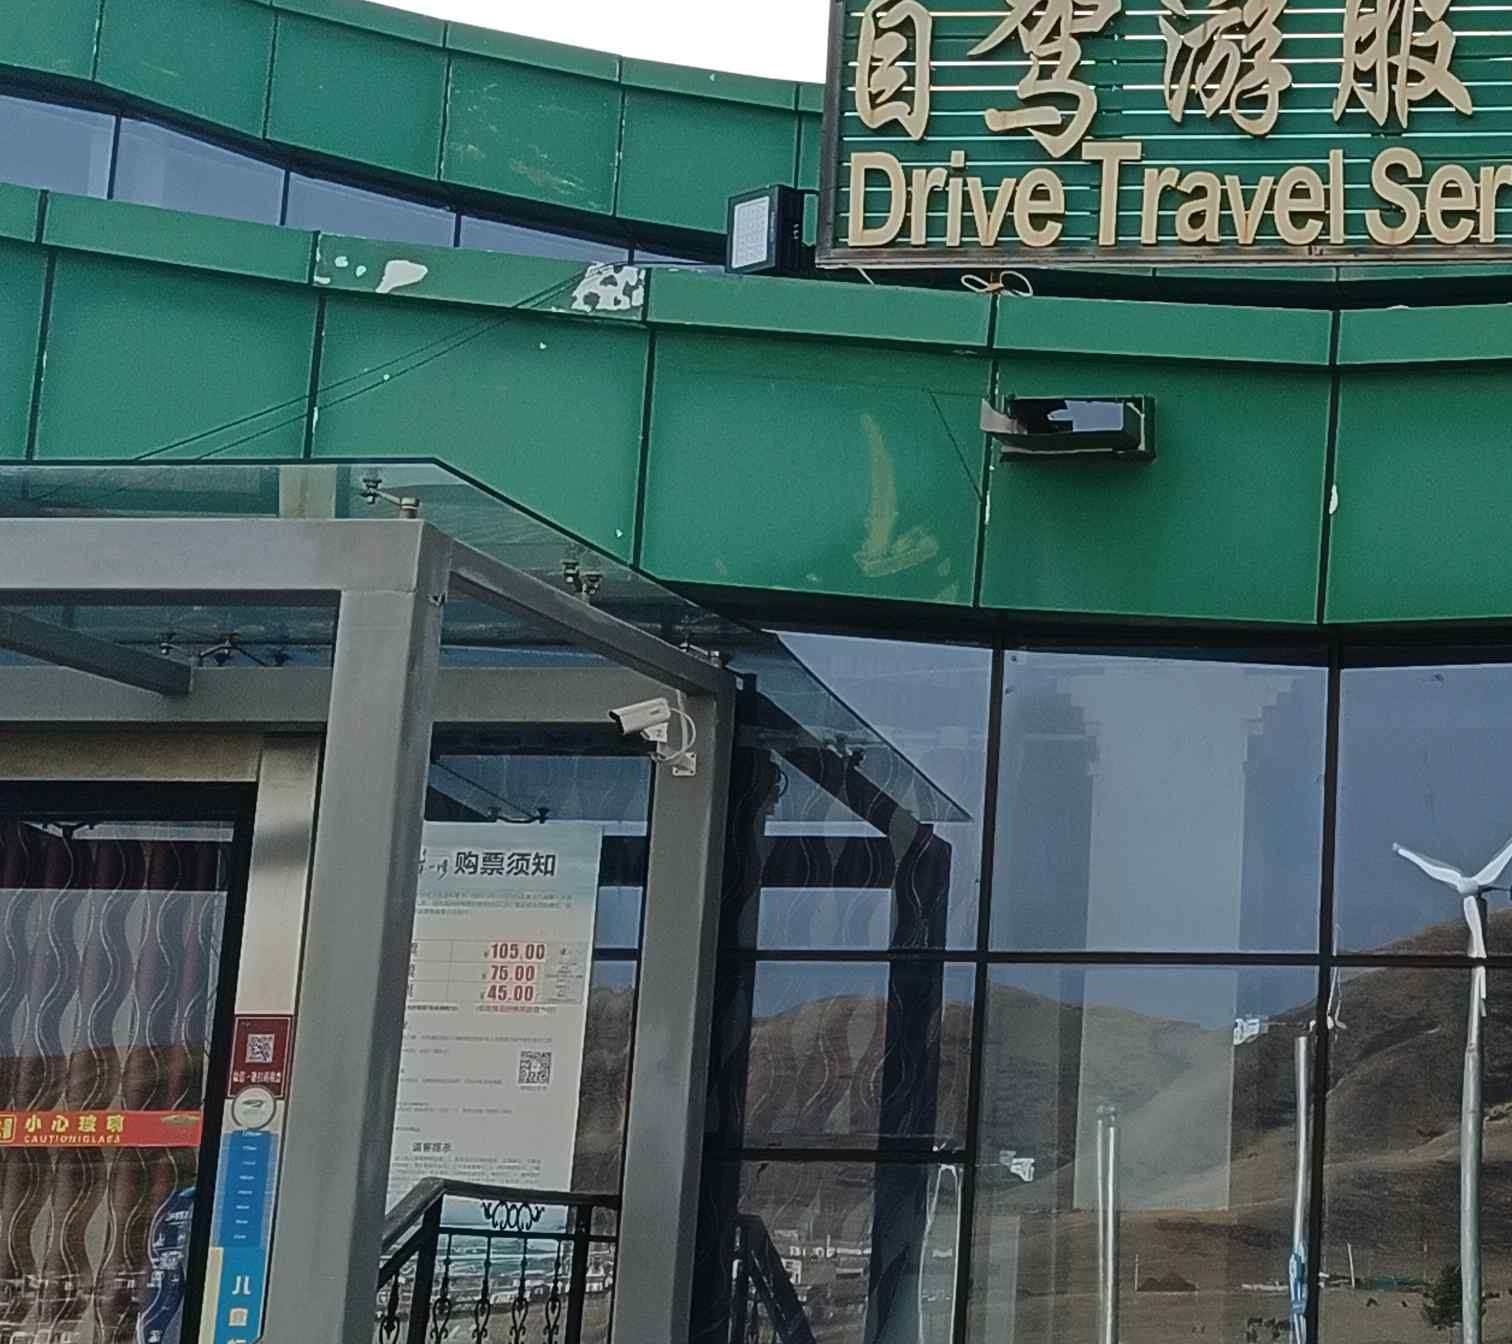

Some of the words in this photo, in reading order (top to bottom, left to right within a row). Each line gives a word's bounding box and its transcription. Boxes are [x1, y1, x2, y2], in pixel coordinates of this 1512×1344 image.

[848, 150, 1066, 248] Drive
[1082, 141, 1344, 247] Travel
[454, 851, 557, 876] 购票须知
[25, 1114, 124, 1133] 小心玻璃
